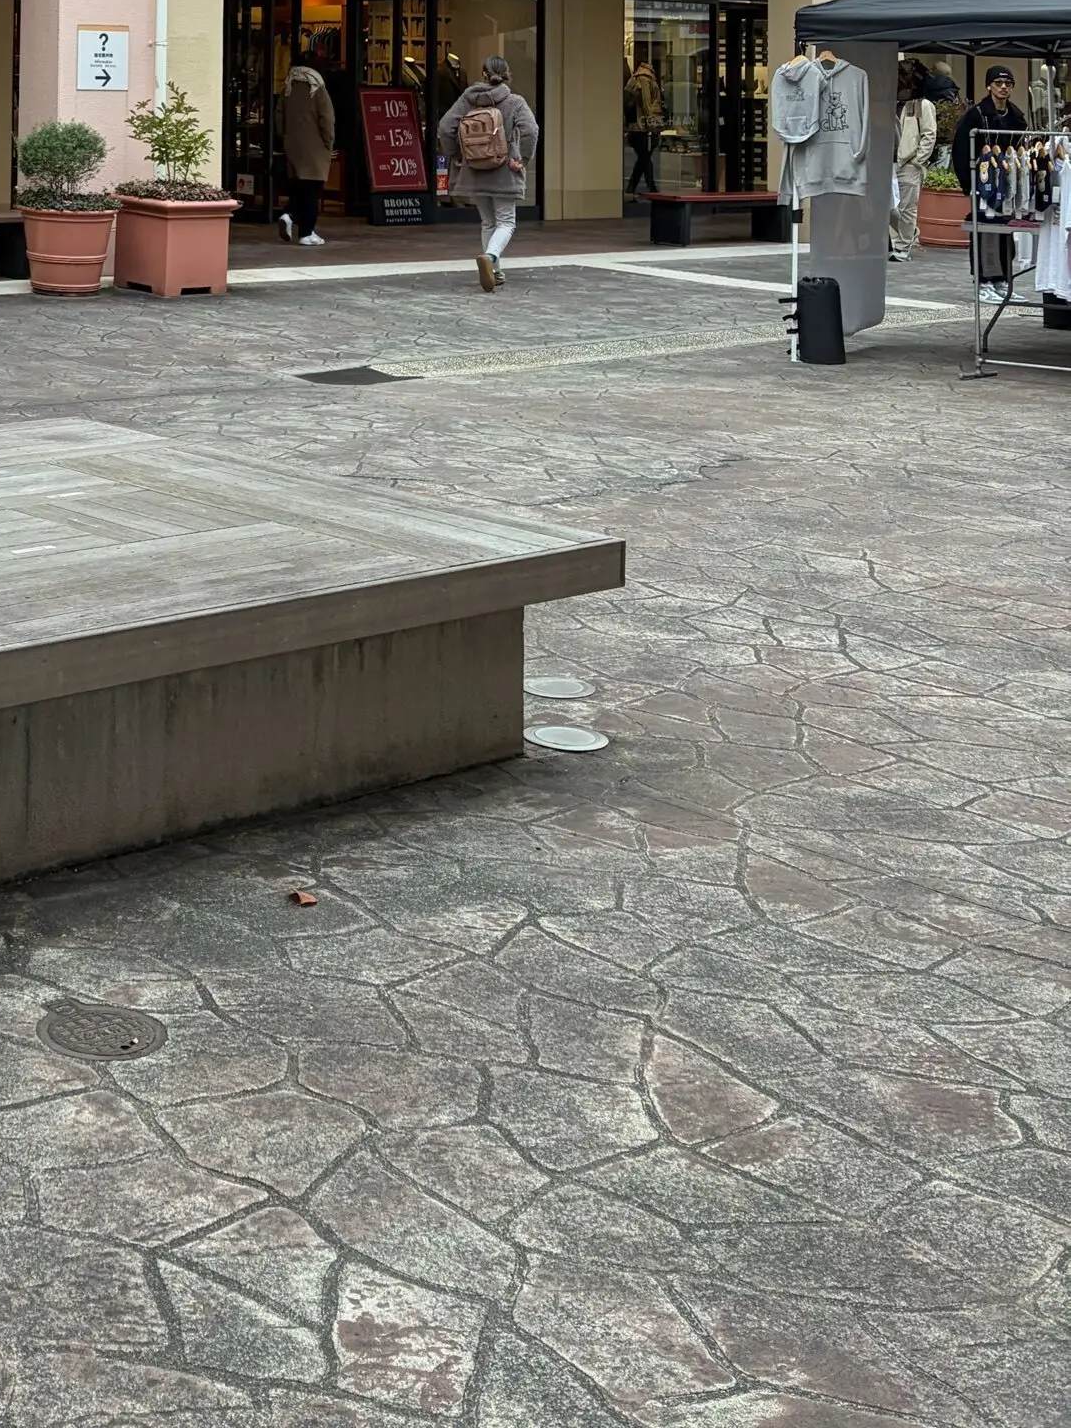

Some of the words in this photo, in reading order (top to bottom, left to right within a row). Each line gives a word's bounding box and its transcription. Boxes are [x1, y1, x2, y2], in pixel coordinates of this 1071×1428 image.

[384, 100, 408, 118] 10%
[389, 129, 413, 147] 15%
[390, 157, 417, 176] 20%
[383, 198, 421, 208] BROOKS
[384, 208, 422, 216] BROTHERS
